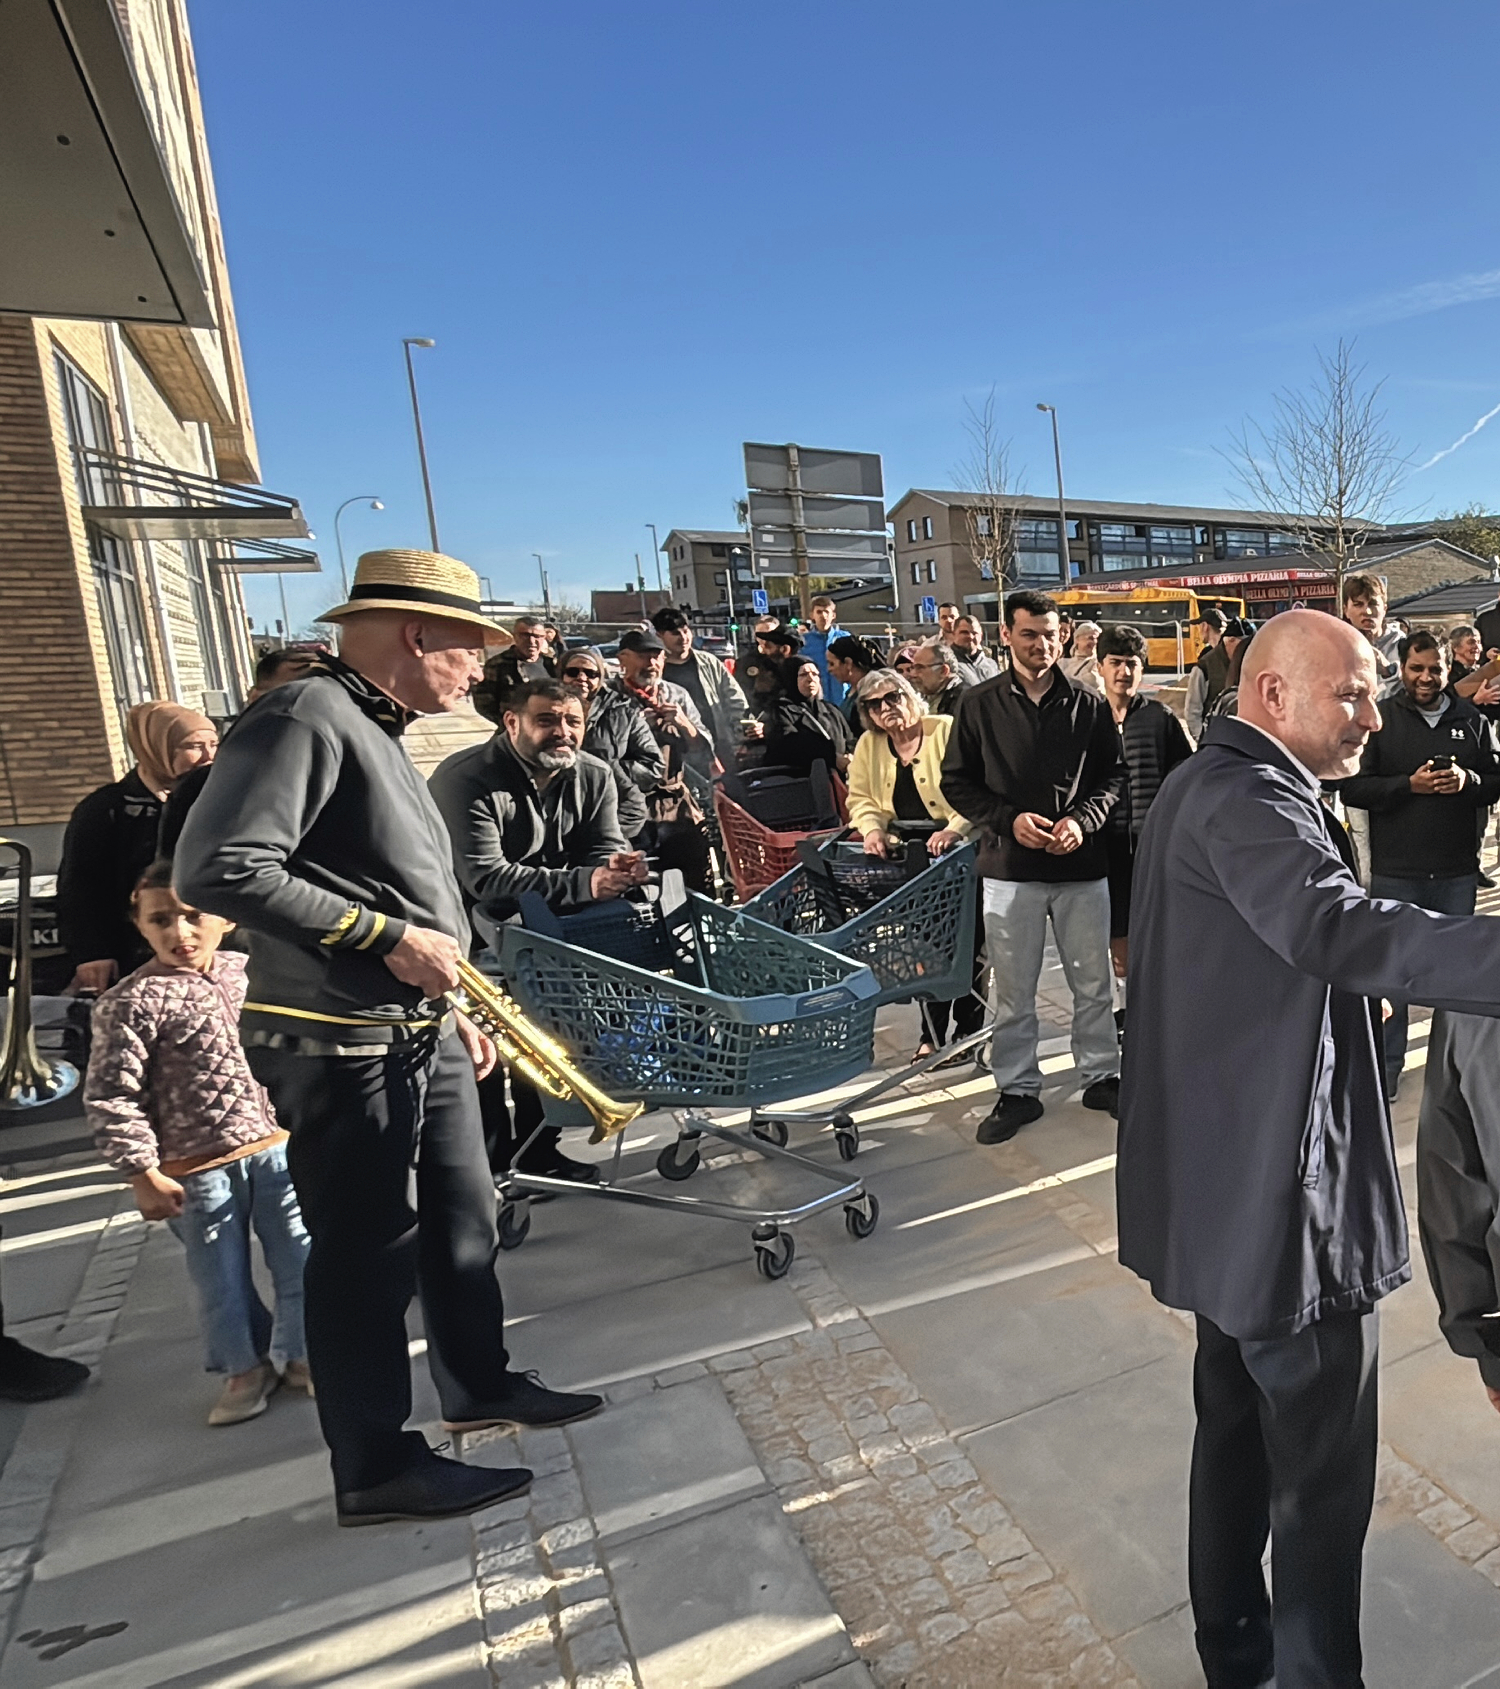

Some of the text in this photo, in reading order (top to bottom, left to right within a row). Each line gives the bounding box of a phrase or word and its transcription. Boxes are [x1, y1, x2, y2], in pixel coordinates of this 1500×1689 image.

[1187, 571, 1289, 586] BELLA OLYMPIA PIZZARIA
[1300, 584, 1335, 597] PIZZARIA
[31, 928, 59, 945] KI
